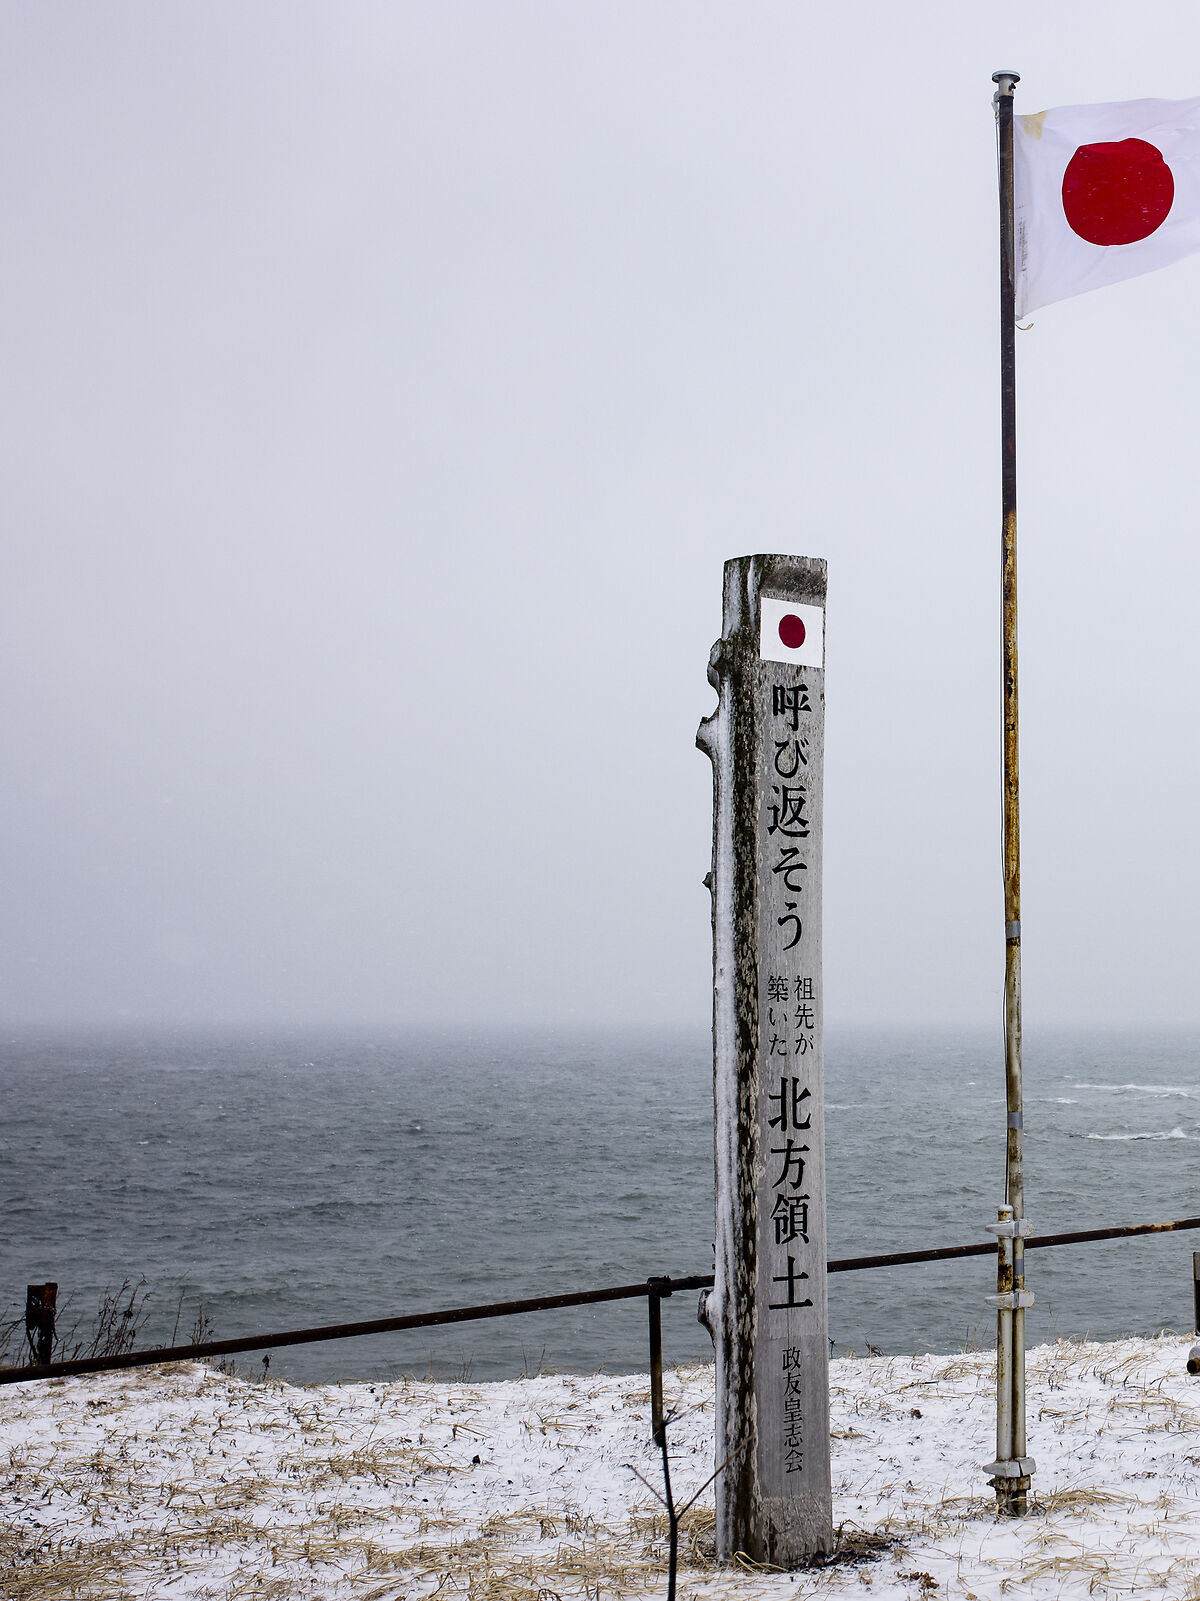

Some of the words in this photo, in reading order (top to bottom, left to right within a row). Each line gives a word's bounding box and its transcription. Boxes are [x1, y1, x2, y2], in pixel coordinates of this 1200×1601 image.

[767, 683, 812, 952] 呼び返そう
[767, 975, 789, 1056] 築いた
[793, 975, 815, 1056] 祖先が
[768, 1076, 812, 1311] 北方領土
[782, 1346, 803, 1474] 政友皇志会
